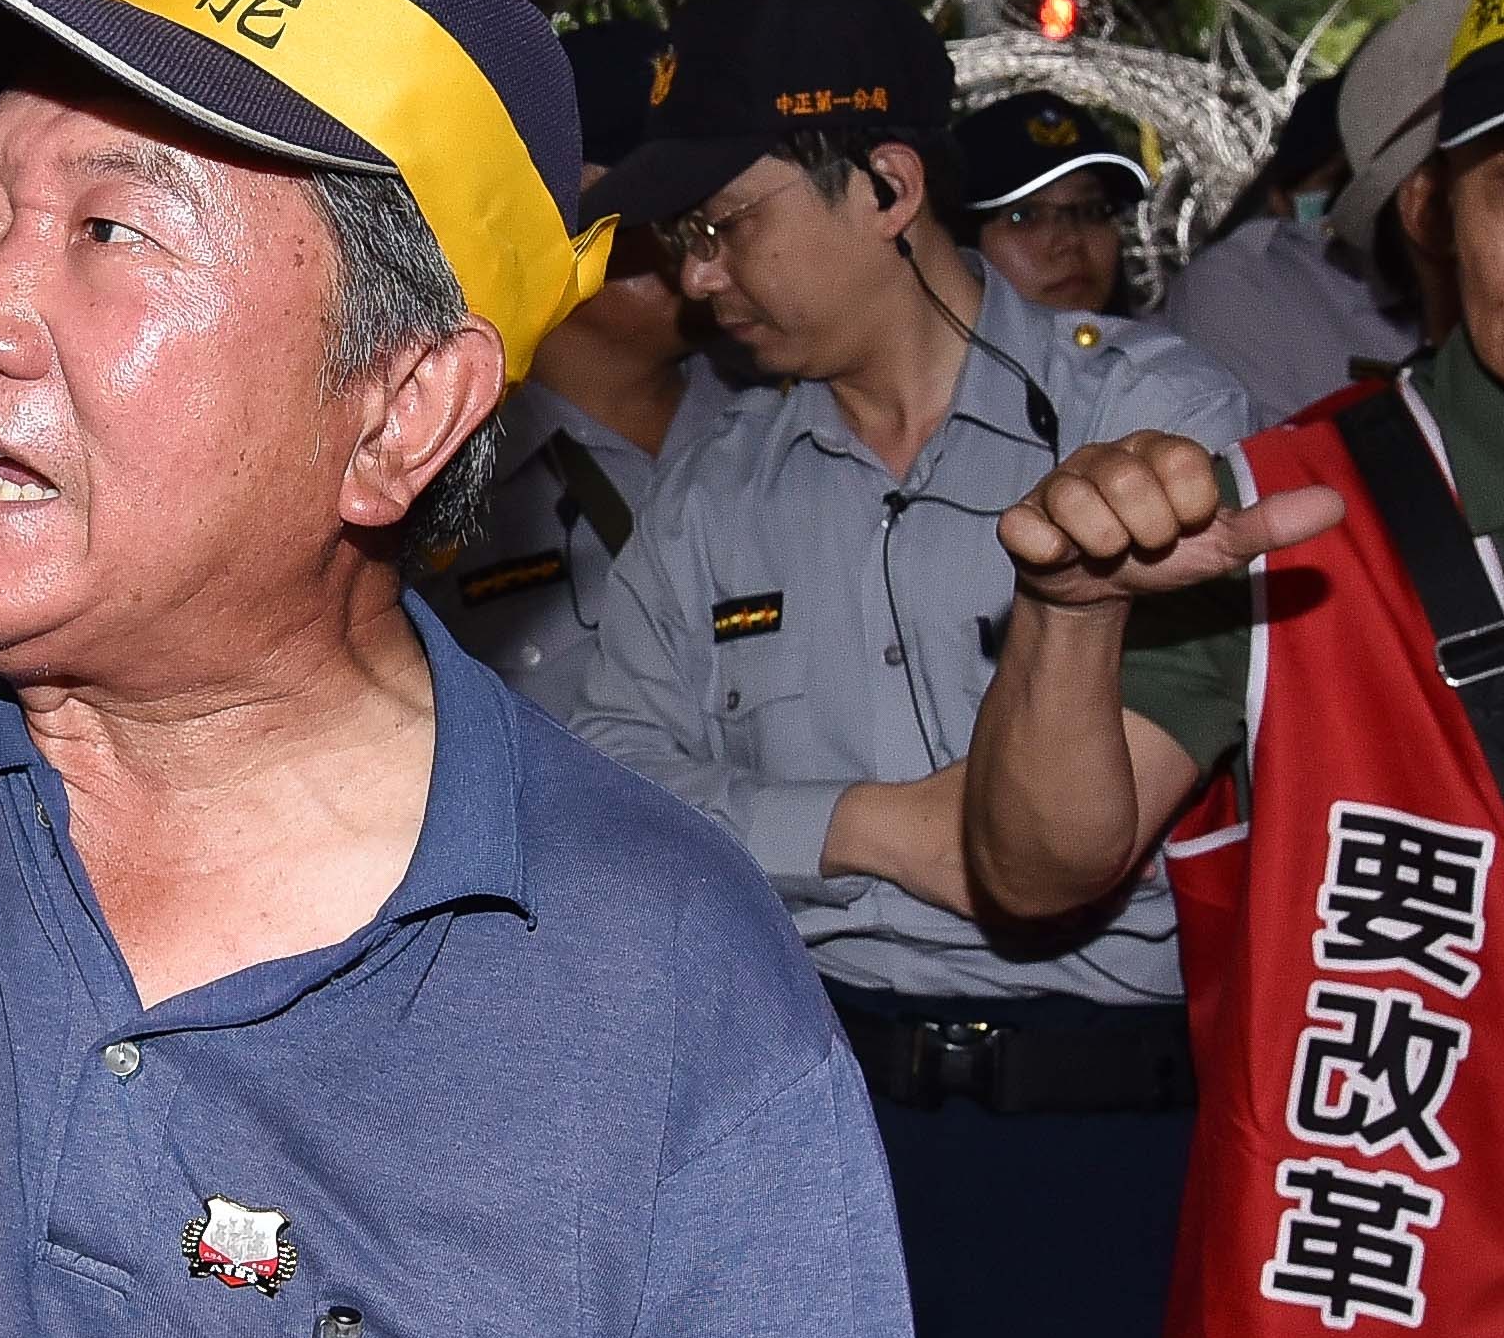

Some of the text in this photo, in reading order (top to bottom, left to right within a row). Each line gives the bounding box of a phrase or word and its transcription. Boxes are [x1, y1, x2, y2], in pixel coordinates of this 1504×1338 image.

[775, 87, 889, 116] 中正第一分局
[1259, 799, 1495, 1331] 要改革
